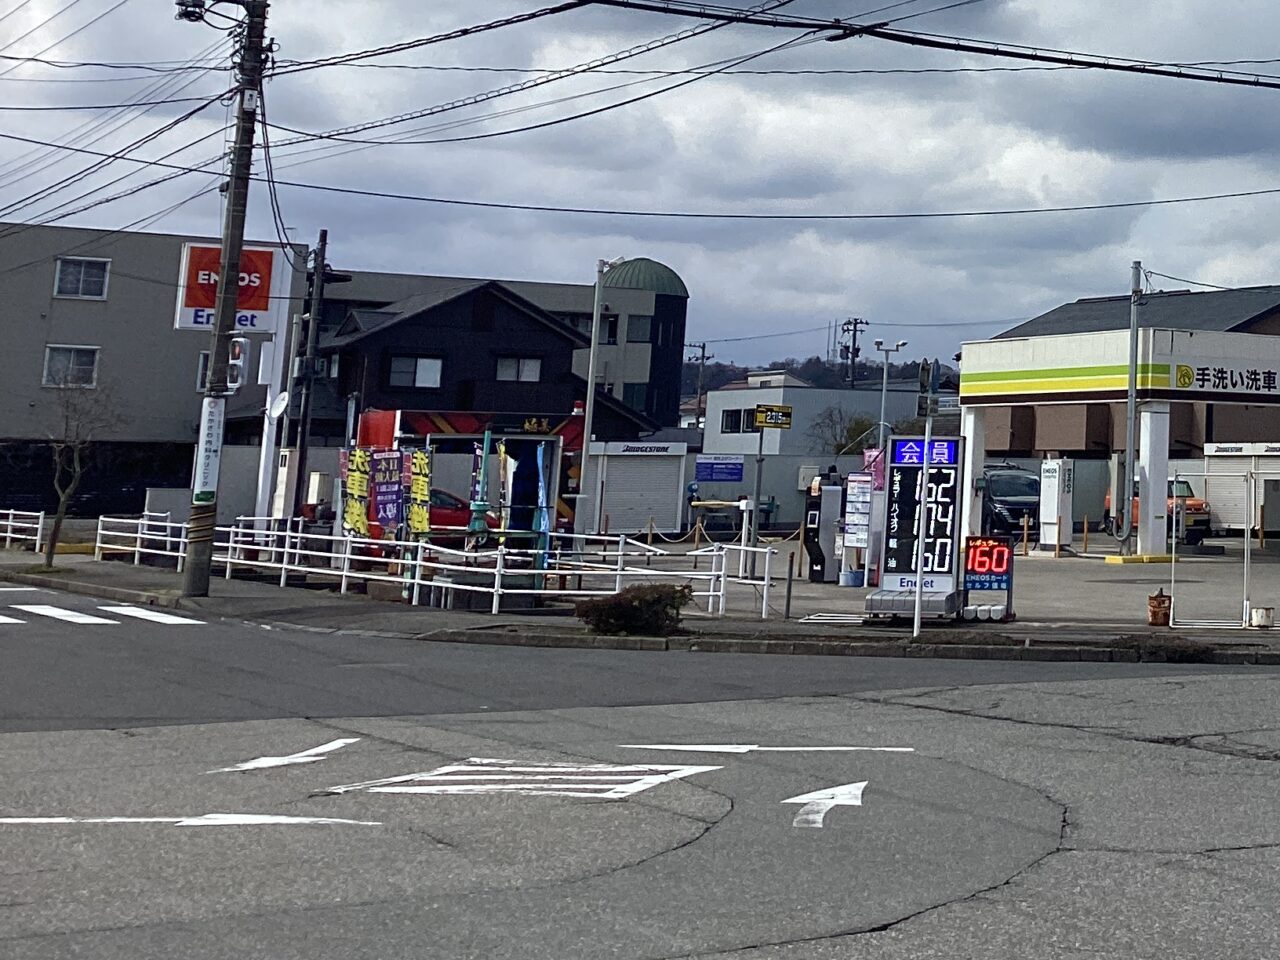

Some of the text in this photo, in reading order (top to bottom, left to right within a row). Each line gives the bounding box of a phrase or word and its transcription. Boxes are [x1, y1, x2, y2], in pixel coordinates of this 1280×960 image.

[197, 270, 261, 286] ENOS
[192, 308, 257, 327] Enet
[1195, 367, 1278, 392] 手洗い洗車
[622, 445, 670, 453] BRIDGESTONE
[900, 441, 949, 464] 会員
[891, 503, 899, 533] ハイオク
[968, 547, 1009, 572] 160
[899, 577, 934, 588] Eneet
